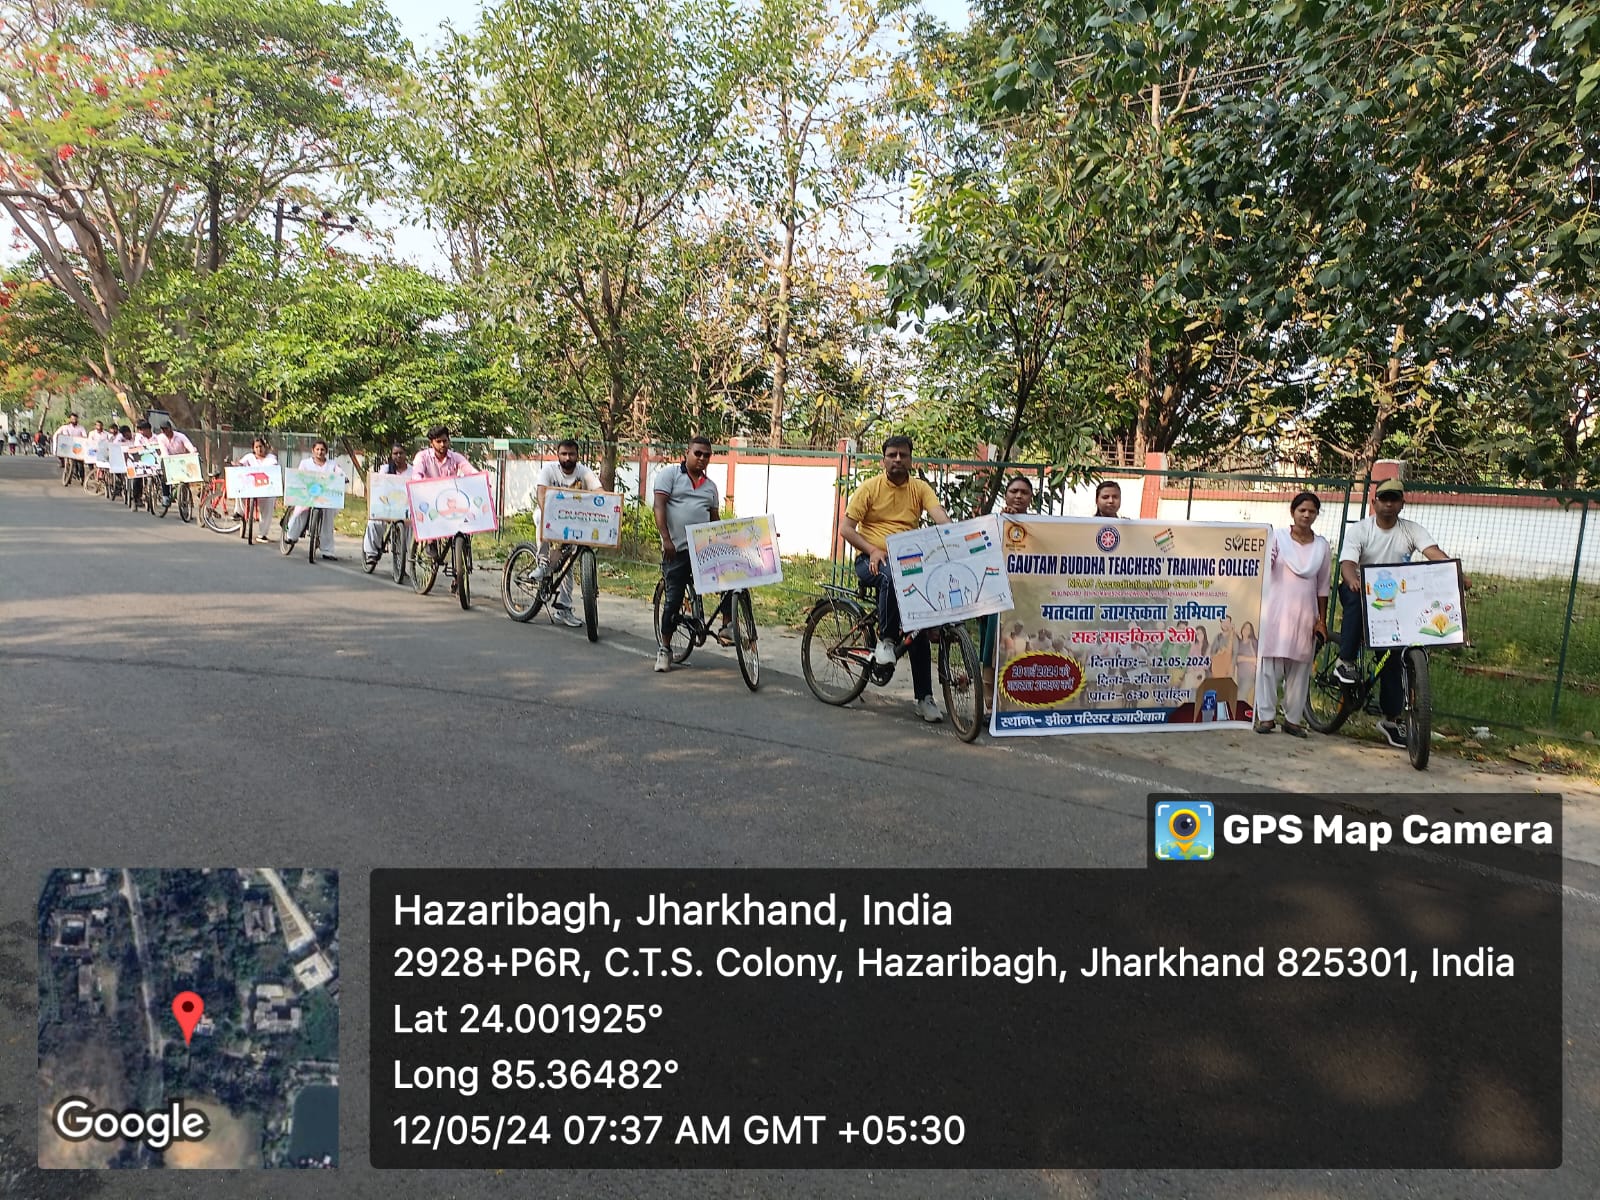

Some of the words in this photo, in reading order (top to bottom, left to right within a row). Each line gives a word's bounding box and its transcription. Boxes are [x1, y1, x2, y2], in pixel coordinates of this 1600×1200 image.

[1224, 534, 1266, 552] SWEEP
[1006, 553, 1058, 575] GAUTAM
[1060, 555, 1106, 575] BUDDHA
[1108, 556, 1166, 576] TEACHERS'
[1167, 557, 1216, 577] TRAINING
[1218, 558, 1260, 577] COLLEGE
[1041, 604, 1095, 621] मतदाता
[1174, 601, 1228, 621] अभियान
[1071, 631, 1099, 645] सह
[1100, 627, 1166, 646] साइकिल
[1168, 627, 1197, 645] रैली
[1152, 656, 1211, 668] 12.05.2024
[1126, 690, 1149, 701] 6:30
[1044, 712, 1073, 726] झील
[1073, 711, 1111, 724] परिसर
[1111, 709, 1167, 723] हजारीबाग
